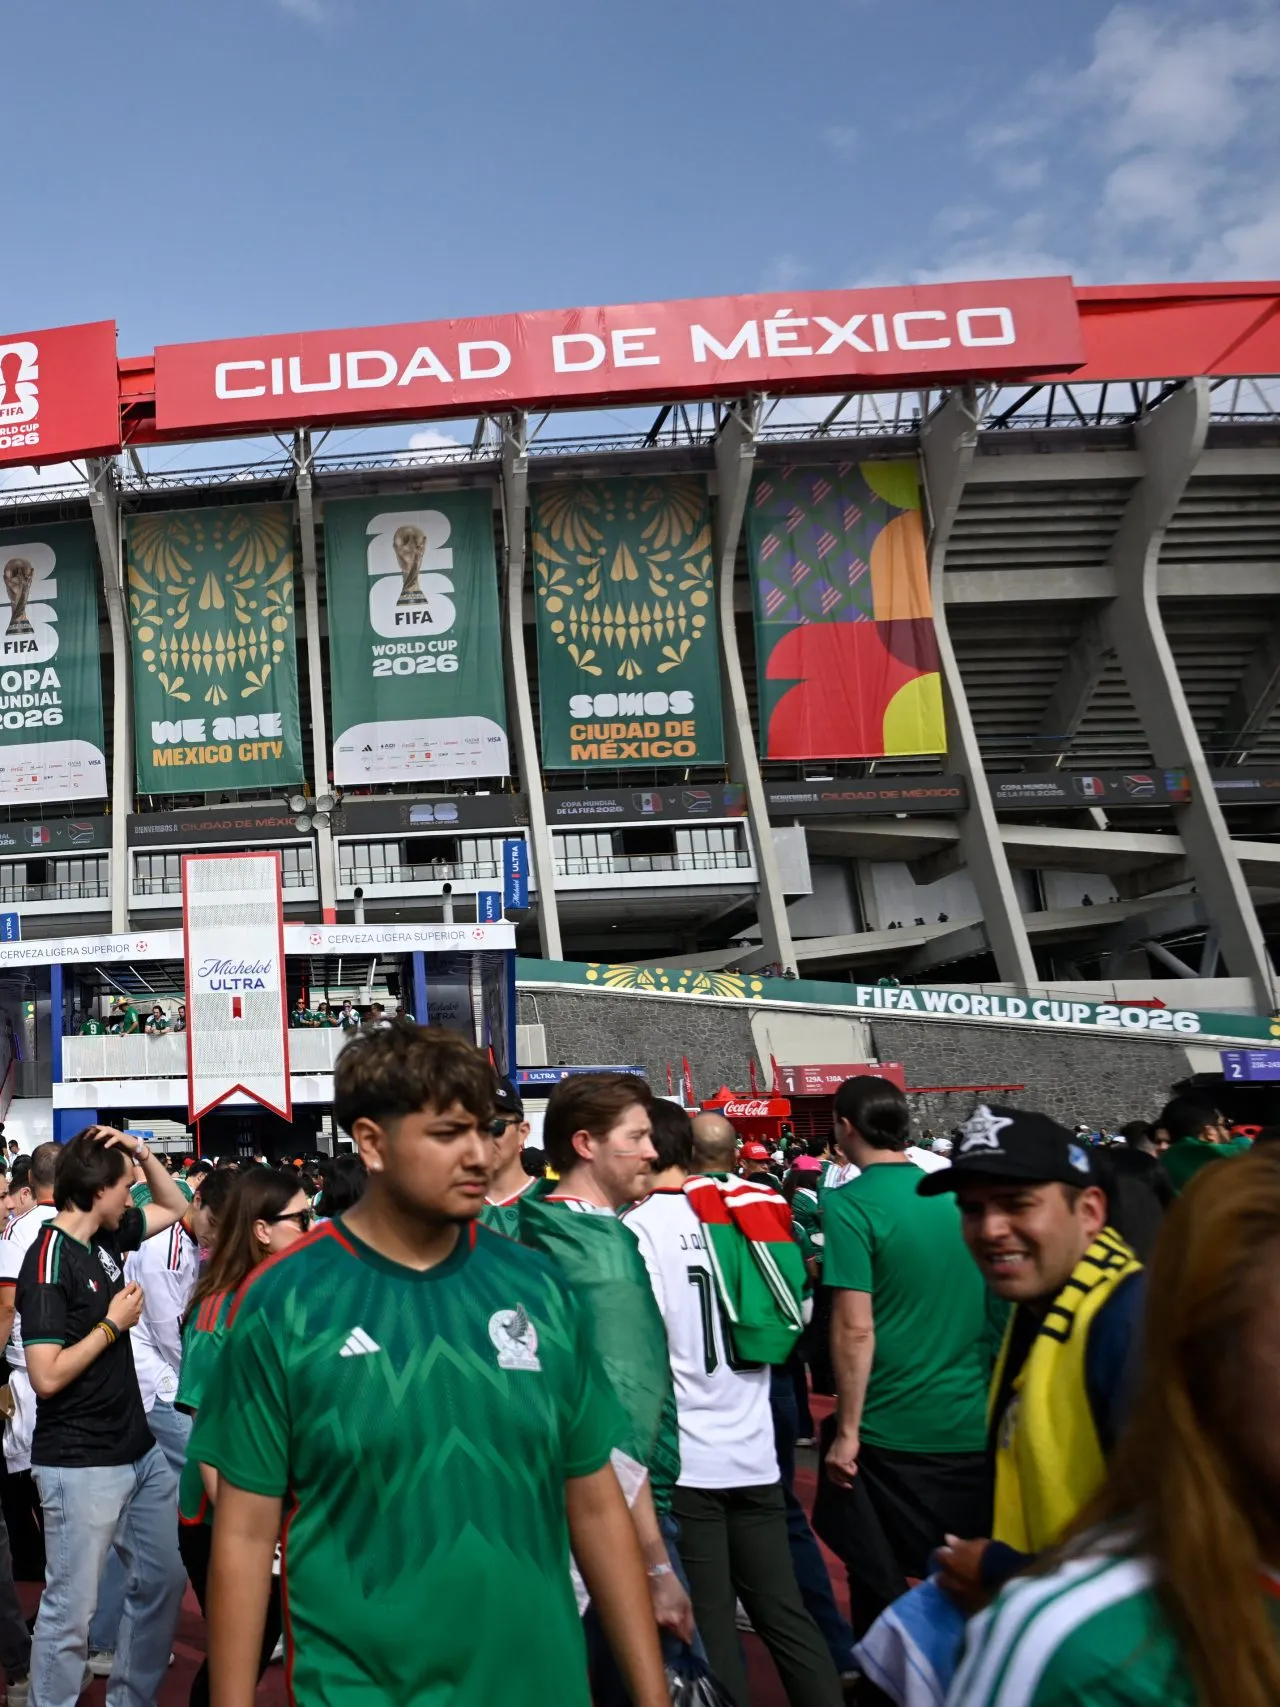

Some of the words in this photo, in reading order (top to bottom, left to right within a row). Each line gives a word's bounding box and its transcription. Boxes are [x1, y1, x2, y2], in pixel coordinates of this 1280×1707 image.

[214, 340, 511, 400] CIUDAD
[552, 327, 660, 373] DE
[690, 306, 1016, 363] MÉXICO
[0, 406, 24, 418] FIFA
[20, 423, 40, 433] CUP
[394, 610, 433, 626] FIFA
[4, 640, 38, 654] FIFA
[372, 642, 426, 656] WORLD
[428, 640, 458, 652] CUP
[372, 654, 458, 677] 2026
[569, 690, 694, 718] SOMOS
[152, 718, 206, 744] WE
[570, 722, 660, 740] CIUDAD
[665, 720, 696, 738] DE
[152, 744, 232, 766] MEXICO
[238, 741, 283, 762] CITY
[571, 739, 696, 760] MÉXICO
[821, 791, 876, 800] CIUDAD
[879, 790, 899, 799] DE
[181, 820, 232, 831] CIUDAD
[235, 820, 252, 828] DE
[255, 817, 297, 827] MÉXIC
[328, 932, 374, 944] CERVEZA
[376, 932, 412, 942] LIGERA
[414, 931, 465, 941] SUPERIOR
[0, 948, 44, 960] CERVEZA
[46, 946, 79, 957] LIGERA
[81, 944, 130, 955] SUPERIOR
[198, 958, 272, 978] Michelob
[210, 978, 265, 990] ULTRA
[856, 986, 919, 1011] FIFA
[920, 991, 1027, 1019] WORLD
[1032, 1000, 1091, 1024] CUP
[1096, 1004, 1201, 1033] 2026
[90, 1024, 97, 1034] 9
[1230, 1064, 1243, 1078] 2
[786, 1078, 794, 1092] 1
[724, 1100, 769, 1116] Coca-Cola
